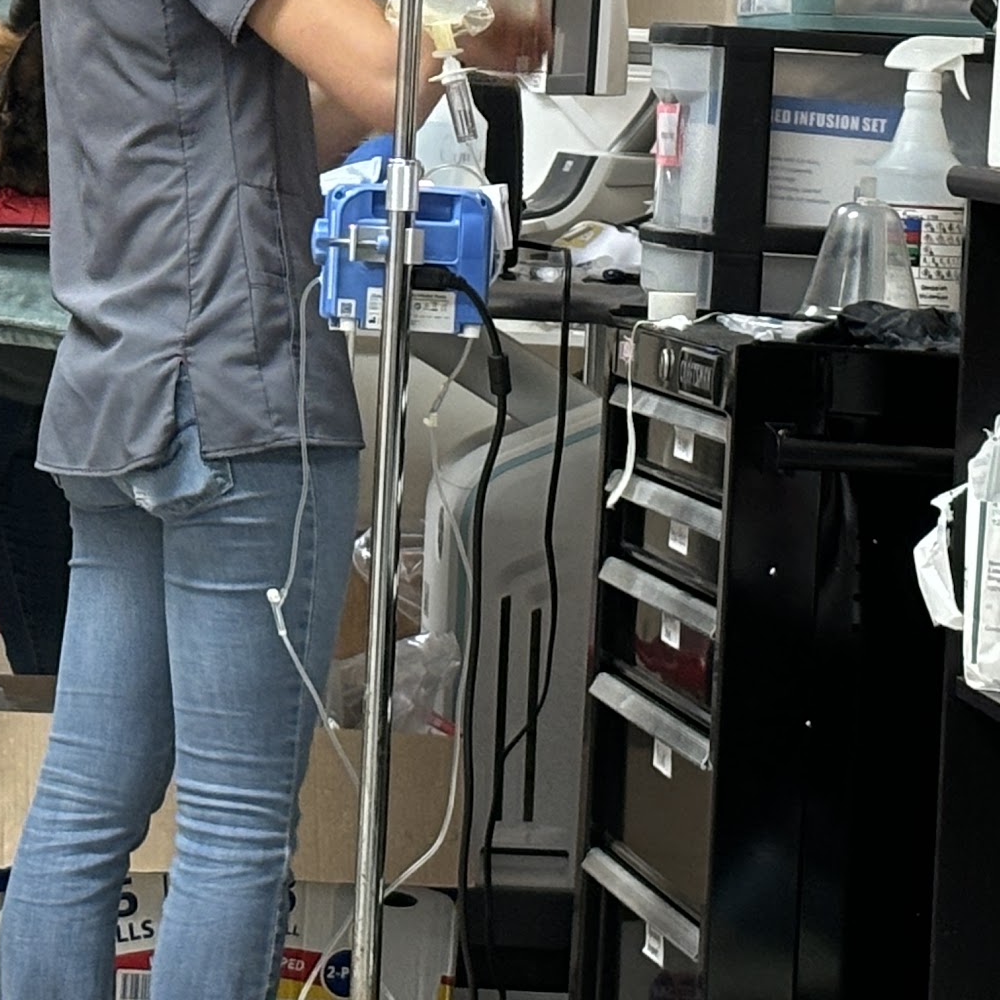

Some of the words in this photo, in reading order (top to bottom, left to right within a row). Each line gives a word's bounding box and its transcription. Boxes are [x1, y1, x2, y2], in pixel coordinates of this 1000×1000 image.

[771, 108, 792, 125] ED
[794, 110, 860, 132] INFUSION
[861, 116, 888, 134] SET
